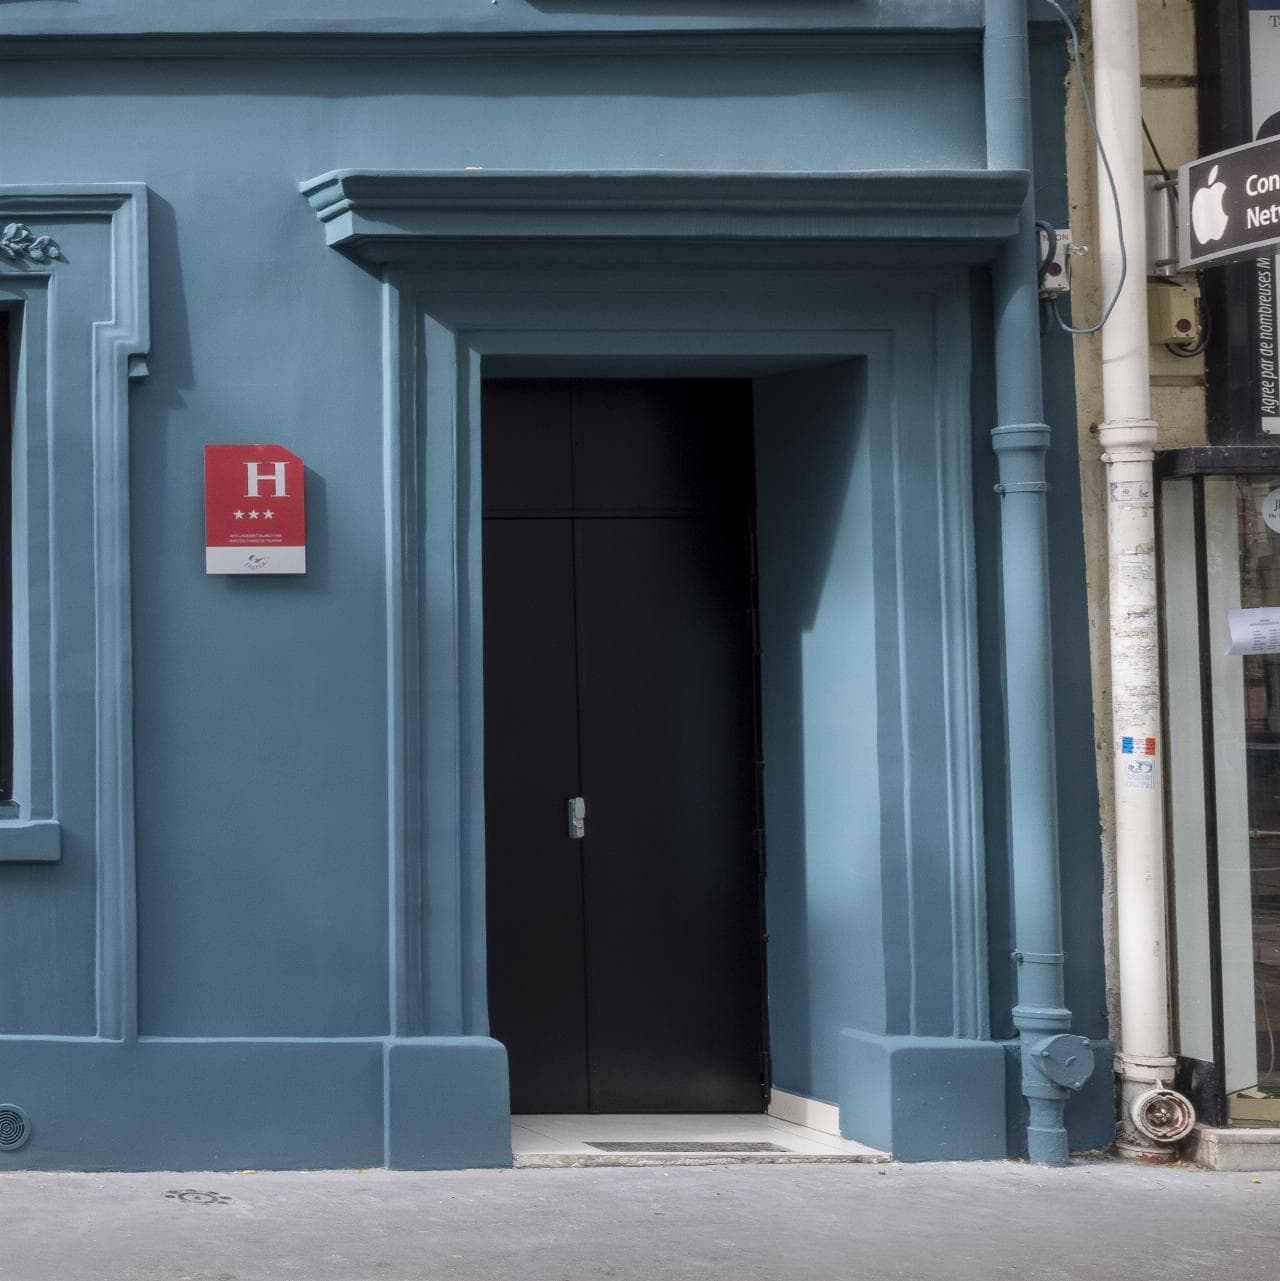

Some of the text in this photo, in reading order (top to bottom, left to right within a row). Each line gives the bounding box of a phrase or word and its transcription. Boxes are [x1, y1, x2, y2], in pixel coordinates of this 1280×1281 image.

[1257, 270, 1274, 340] nombreuses
[1259, 341, 1275, 357] de
[1260, 358, 1278, 380] par
[243, 461, 291, 498] H
